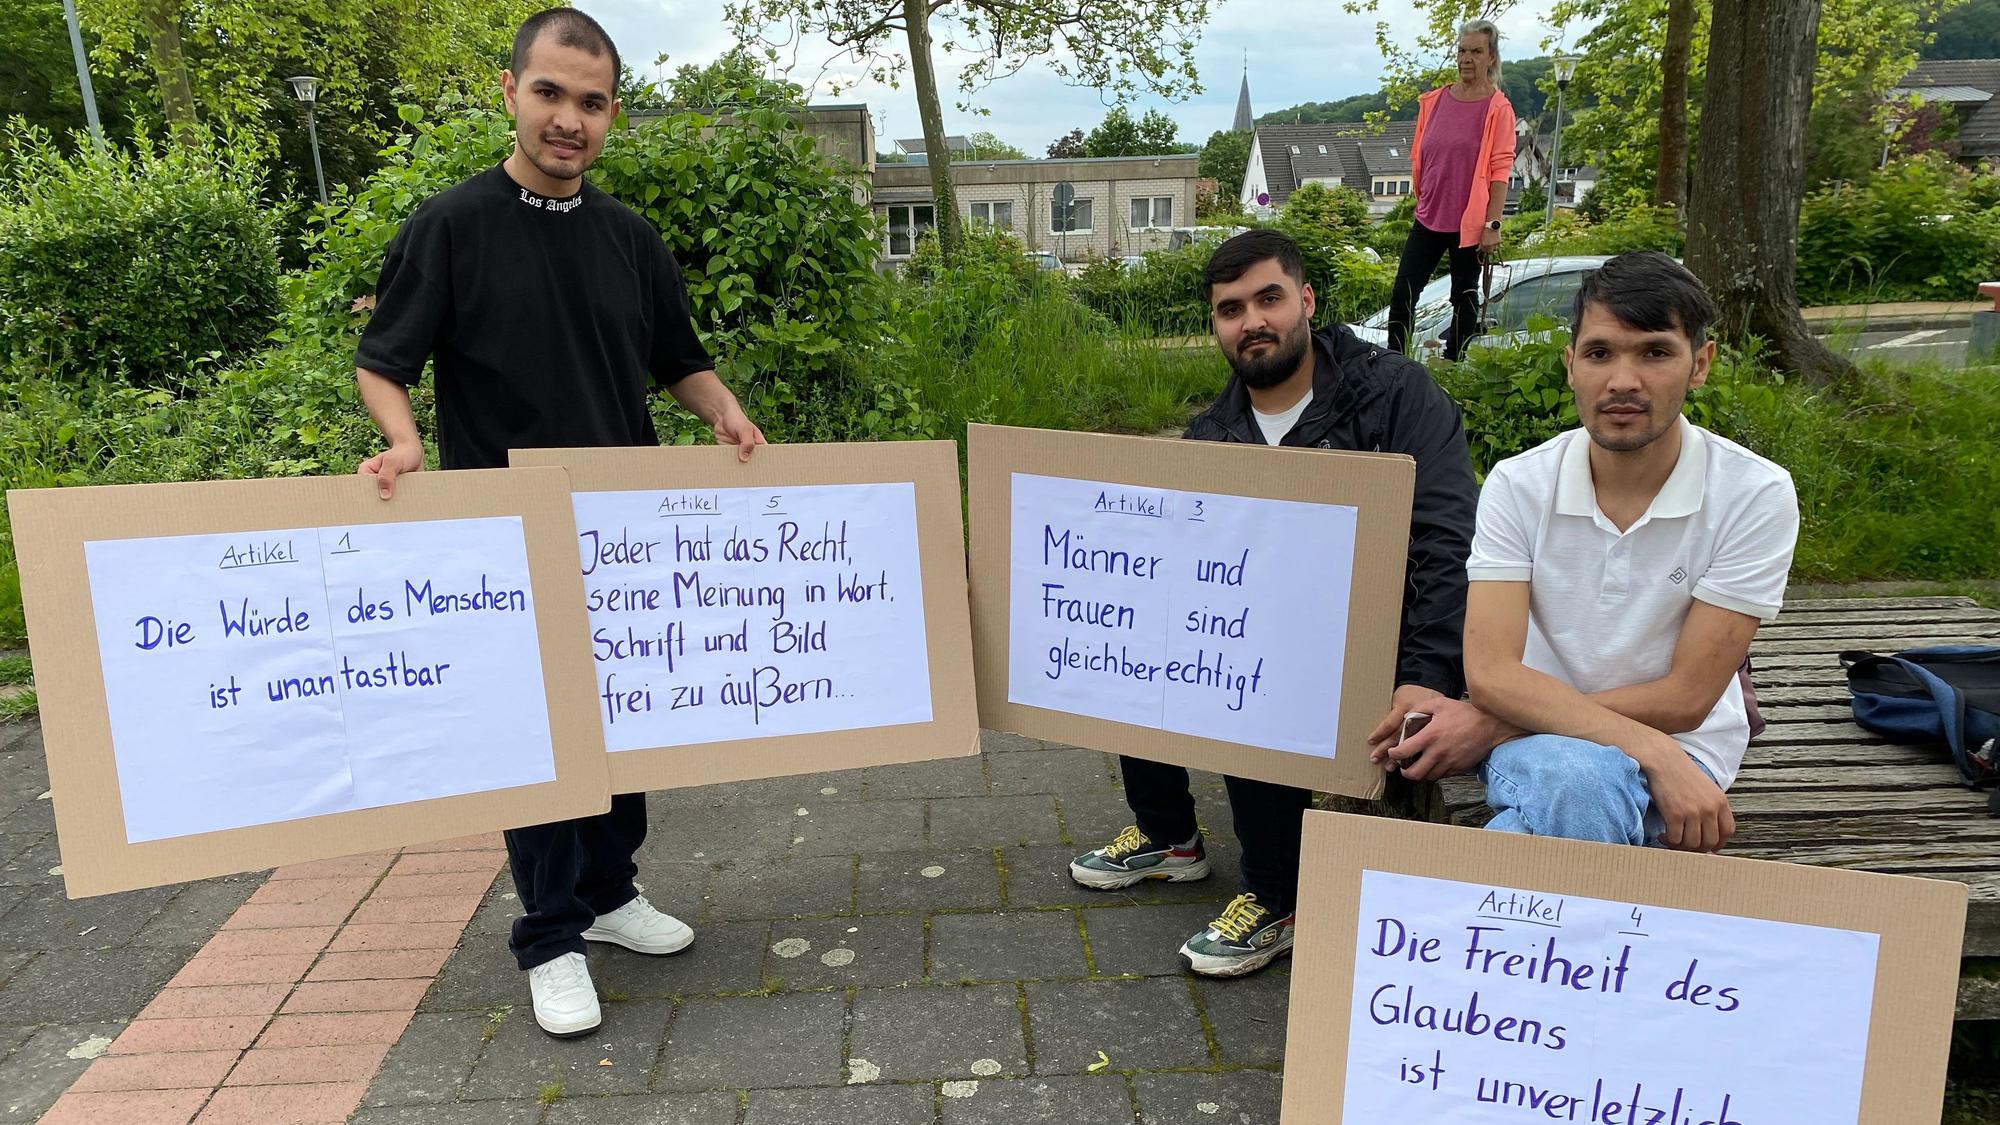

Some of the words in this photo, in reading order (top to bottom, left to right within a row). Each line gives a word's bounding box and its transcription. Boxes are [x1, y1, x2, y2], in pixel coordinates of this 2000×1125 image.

[520, 188, 543, 207] Los
[546, 194, 582, 212] Angeles
[766, 495, 781, 508] 5
[1193, 500, 1205, 516] 3
[338, 532, 351, 550] 1
[579, 526, 661, 576] Jeder
[675, 523, 712, 563] hat
[723, 524, 768, 563] das
[777, 519, 852, 567] Recht,
[1044, 524, 1164, 580] Männer
[1197, 548, 1250, 587] und
[135, 616, 196, 651] Die
[220, 597, 310, 639] Würde
[348, 587, 394, 624] des
[405, 574, 526, 618] Menschen
[586, 582, 660, 612] seine
[673, 571, 785, 621] Meinung
[805, 579, 826, 603] in
[1042, 582, 1135, 630] Frauen
[1185, 606, 1250, 639] sind
[593, 620, 686, 673] Schrift
[705, 618, 748, 653] und
[769, 619, 827, 654] Bild
[210, 676, 242, 709] ist
[601, 672, 651, 725] frei
[671, 685, 704, 711] zu
[1045, 637, 1267, 711] gleichberechtigt.
[1630, 906, 1643, 927] 4
[1370, 918, 1442, 963] Die
[1465, 926, 1632, 994] Freiheit
[1664, 958, 1741, 1012] des
[1369, 984, 1568, 1051] Glaubens
[1400, 1049, 1446, 1091] ist
